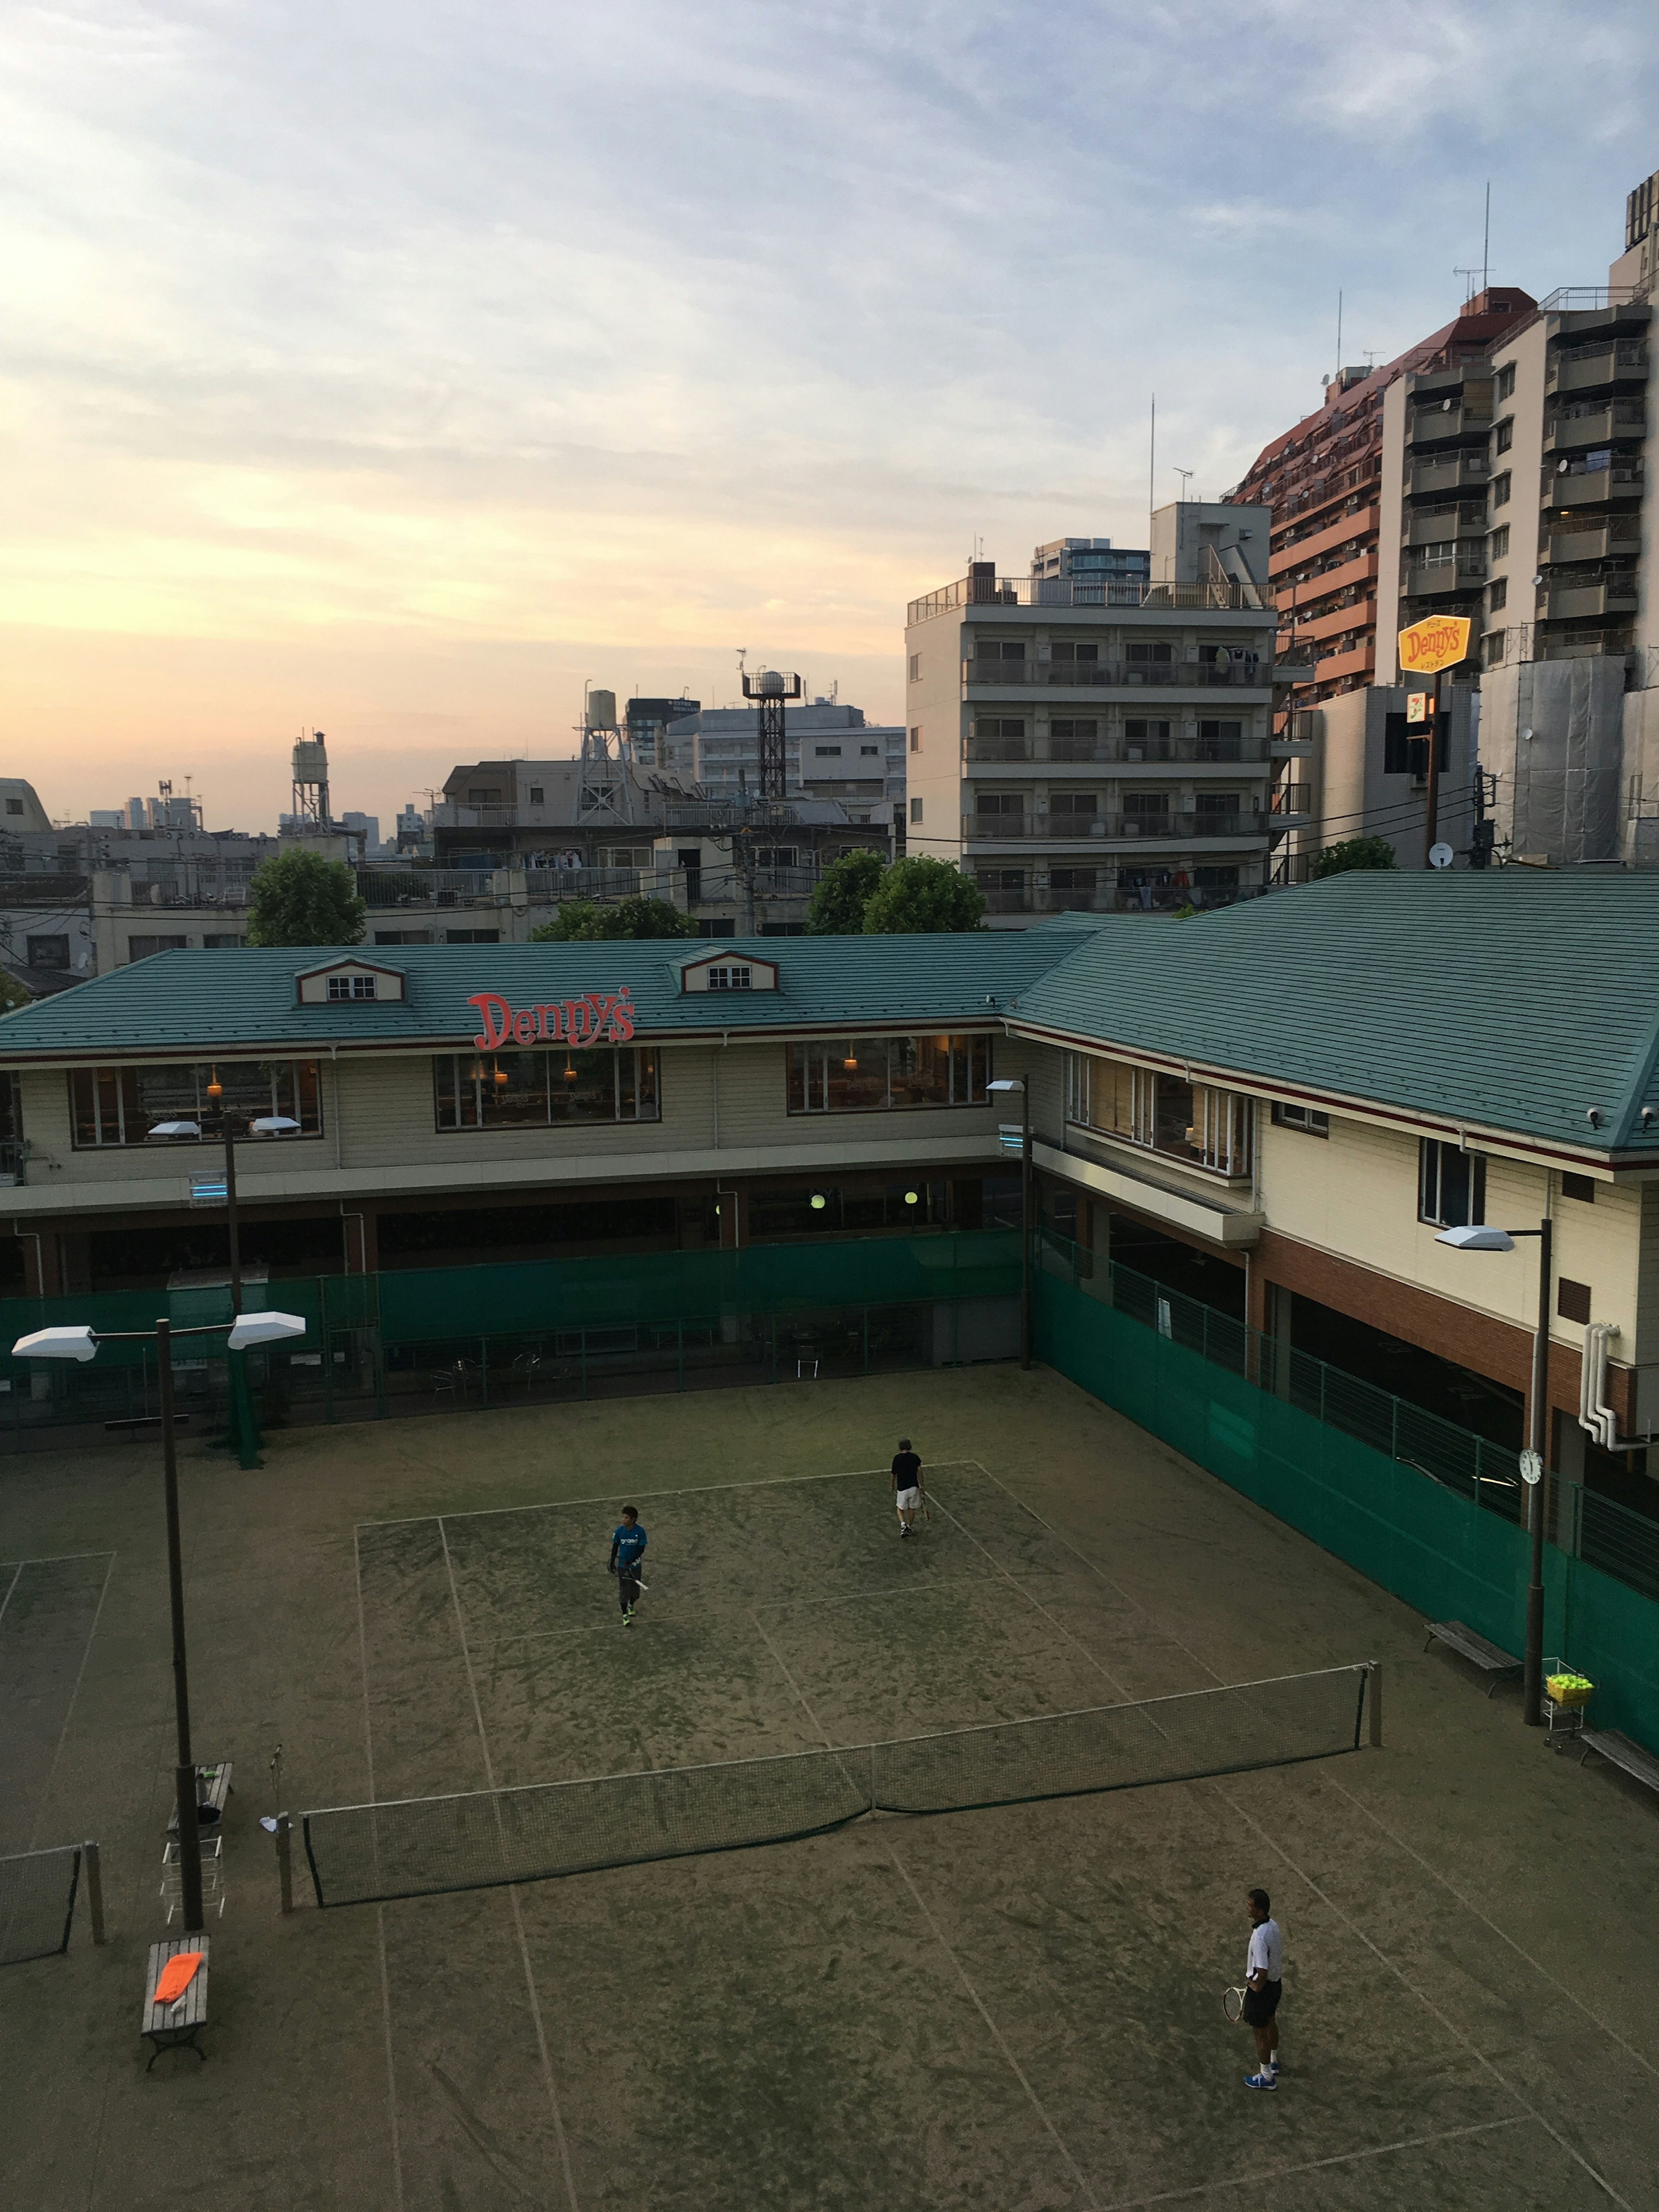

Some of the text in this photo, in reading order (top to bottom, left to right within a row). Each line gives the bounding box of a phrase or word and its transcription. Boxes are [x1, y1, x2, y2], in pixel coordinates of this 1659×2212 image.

[1408, 621, 1460, 663] Denny's
[1421, 660, 1444, 669] レストラン
[467, 986, 634, 1050] Denny's
